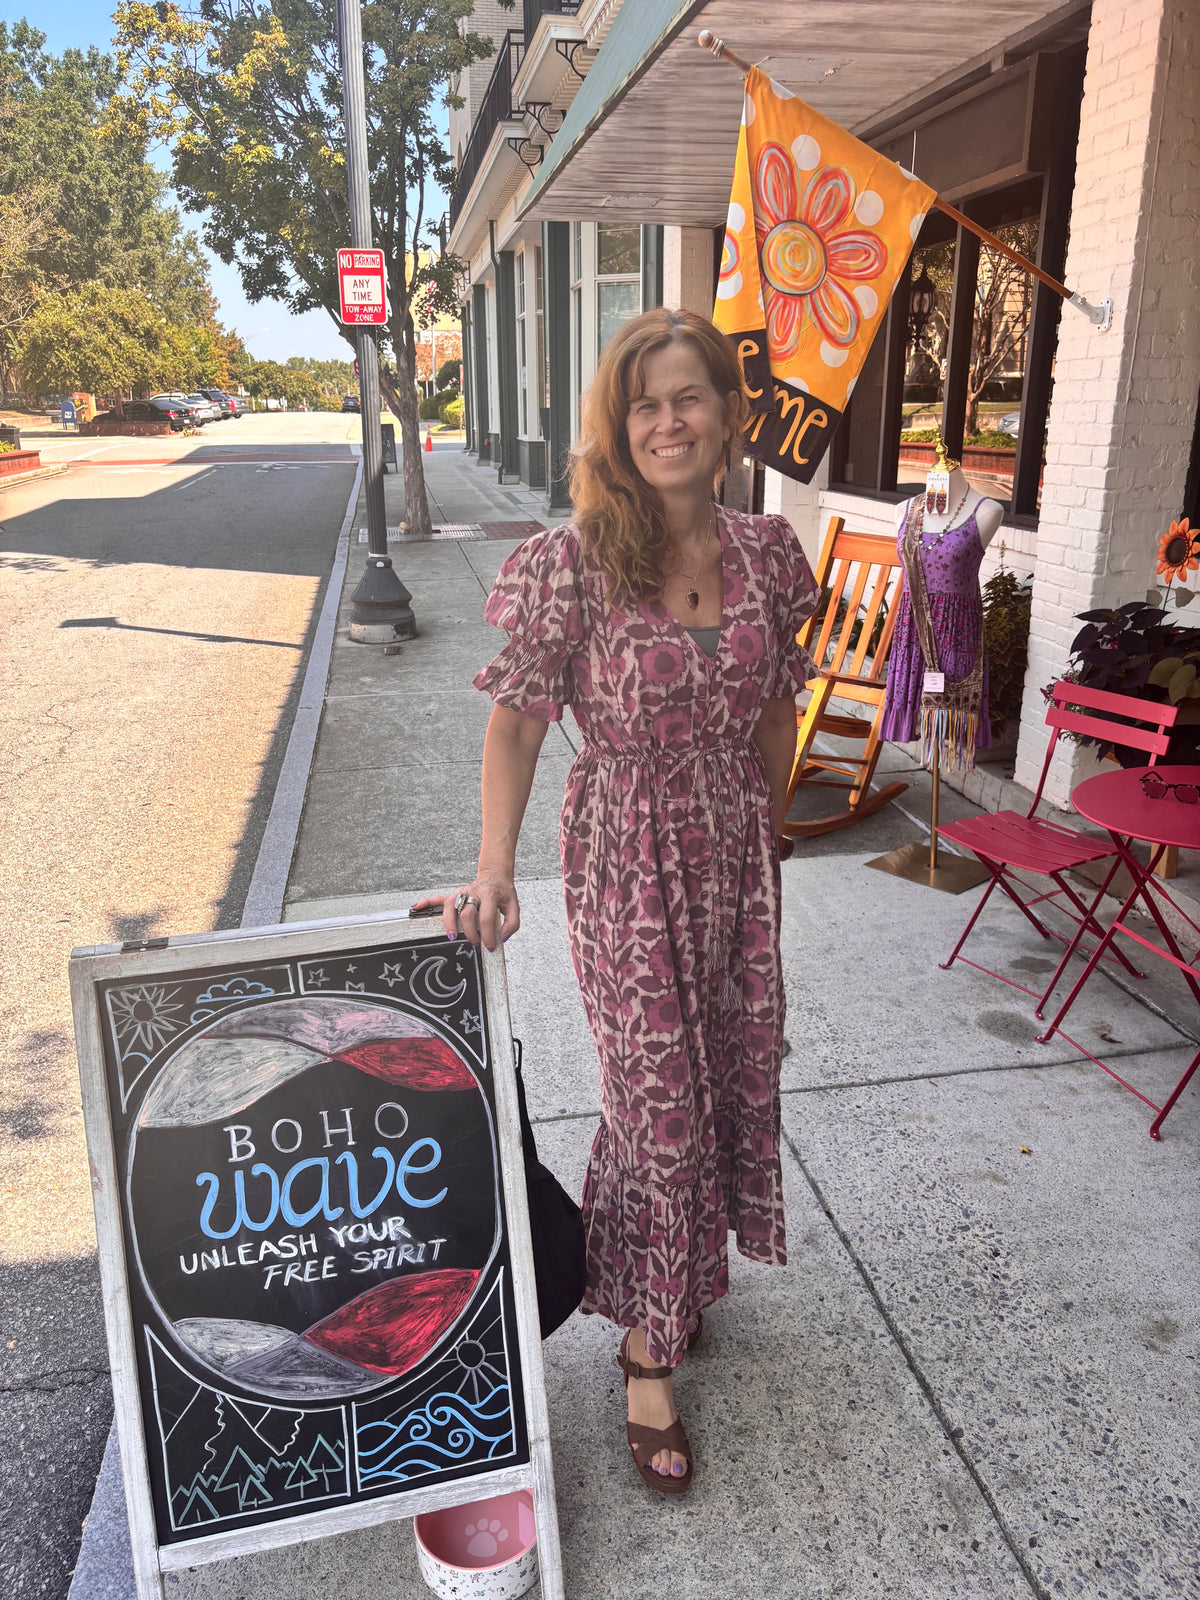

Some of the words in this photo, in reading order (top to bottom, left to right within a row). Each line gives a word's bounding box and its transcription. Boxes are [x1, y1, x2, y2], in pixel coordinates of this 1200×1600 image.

[340, 254, 352, 268] NO
[354, 256, 380, 267] PARKING
[353, 279, 370, 288] ANY
[352, 292, 372, 301] TIME
[345, 305, 383, 314] TOW-AWAY
[355, 314, 375, 322] ZONE
[223, 1102, 409, 1163] BOHO
[195, 1137, 449, 1240] wave
[179, 1233, 318, 1275] UNLEASH
[328, 1216, 412, 1248] YOUR
[263, 1255, 339, 1290] FREE
[350, 1238, 447, 1274] SPIRIT
